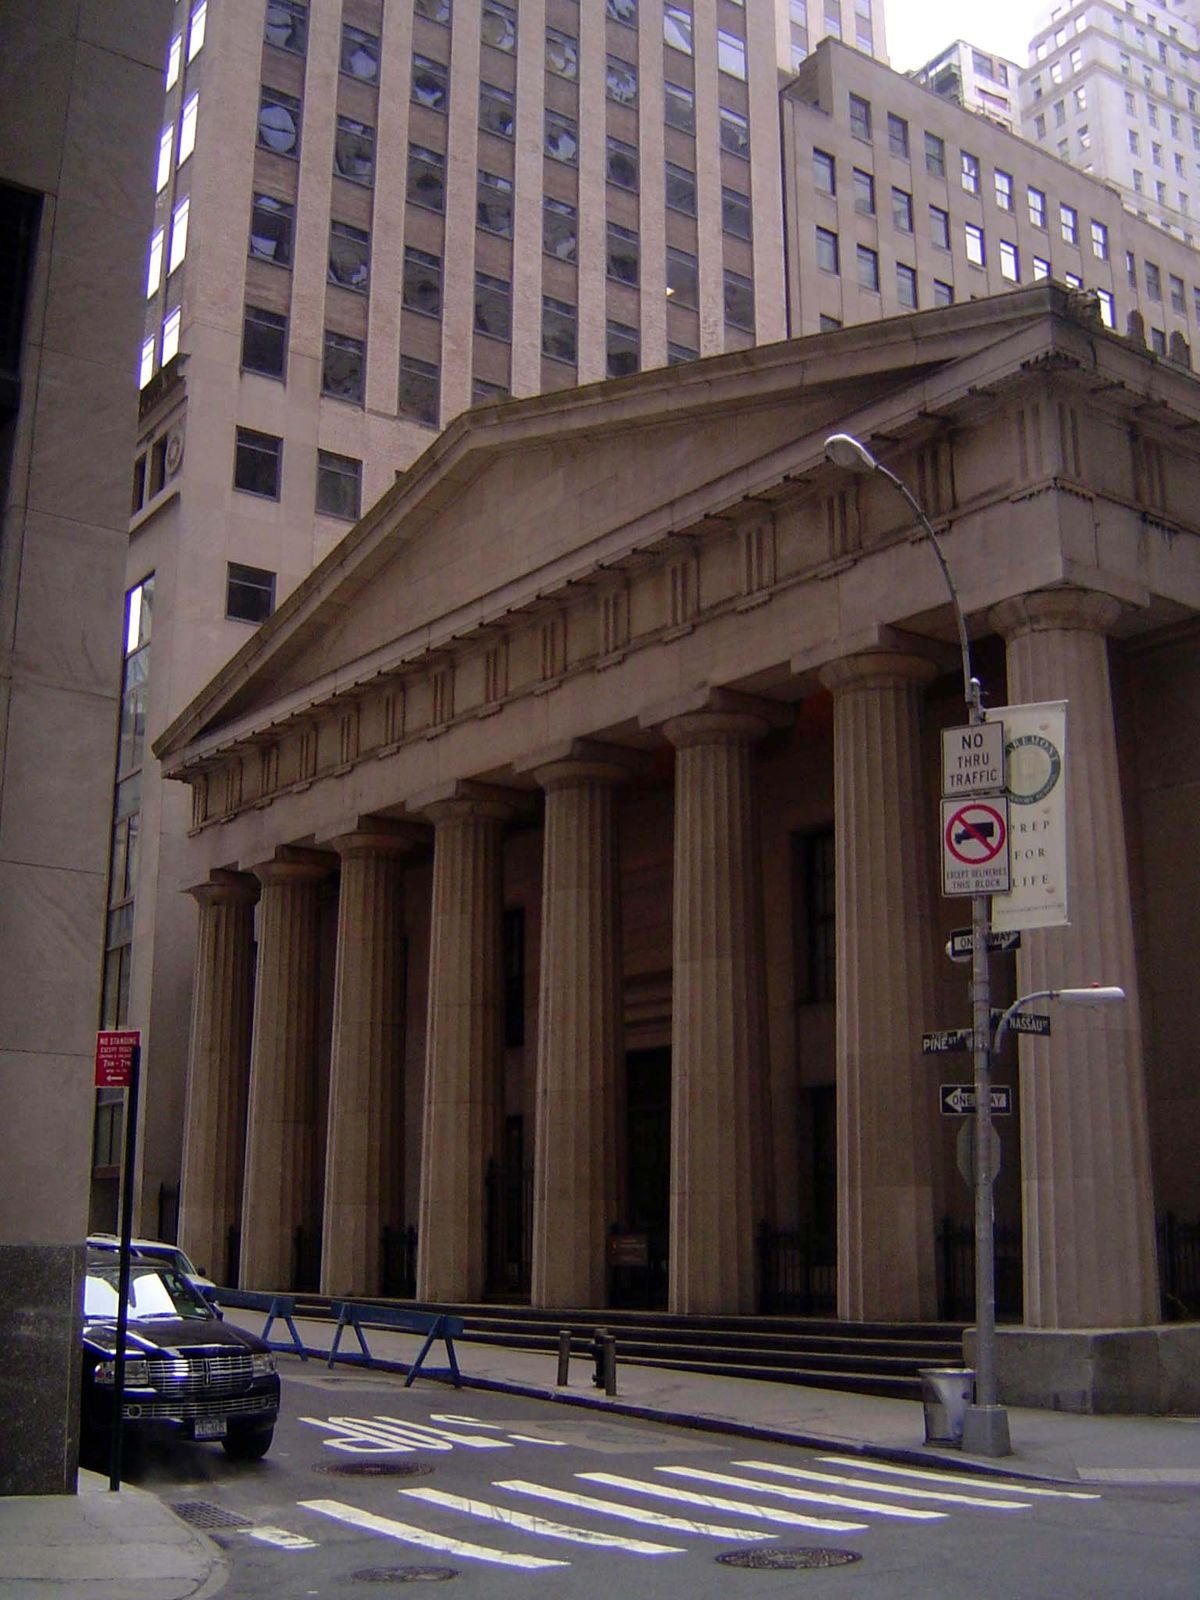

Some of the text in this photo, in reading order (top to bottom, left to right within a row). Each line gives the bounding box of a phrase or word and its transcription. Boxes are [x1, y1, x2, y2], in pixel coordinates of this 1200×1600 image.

[961, 733, 983, 750] NO
[957, 752, 990, 769] THRU
[949, 769, 998, 787] TRAFFIC
[1014, 848, 1046, 860] FOR
[951, 877, 1001, 890] THIS BLOCK
[1012, 875, 1049, 888] LIFE
[1009, 1016, 1042, 1032] NASSAU
[923, 1036, 948, 1052] PINE
[952, 1095, 972, 1106] ONE
